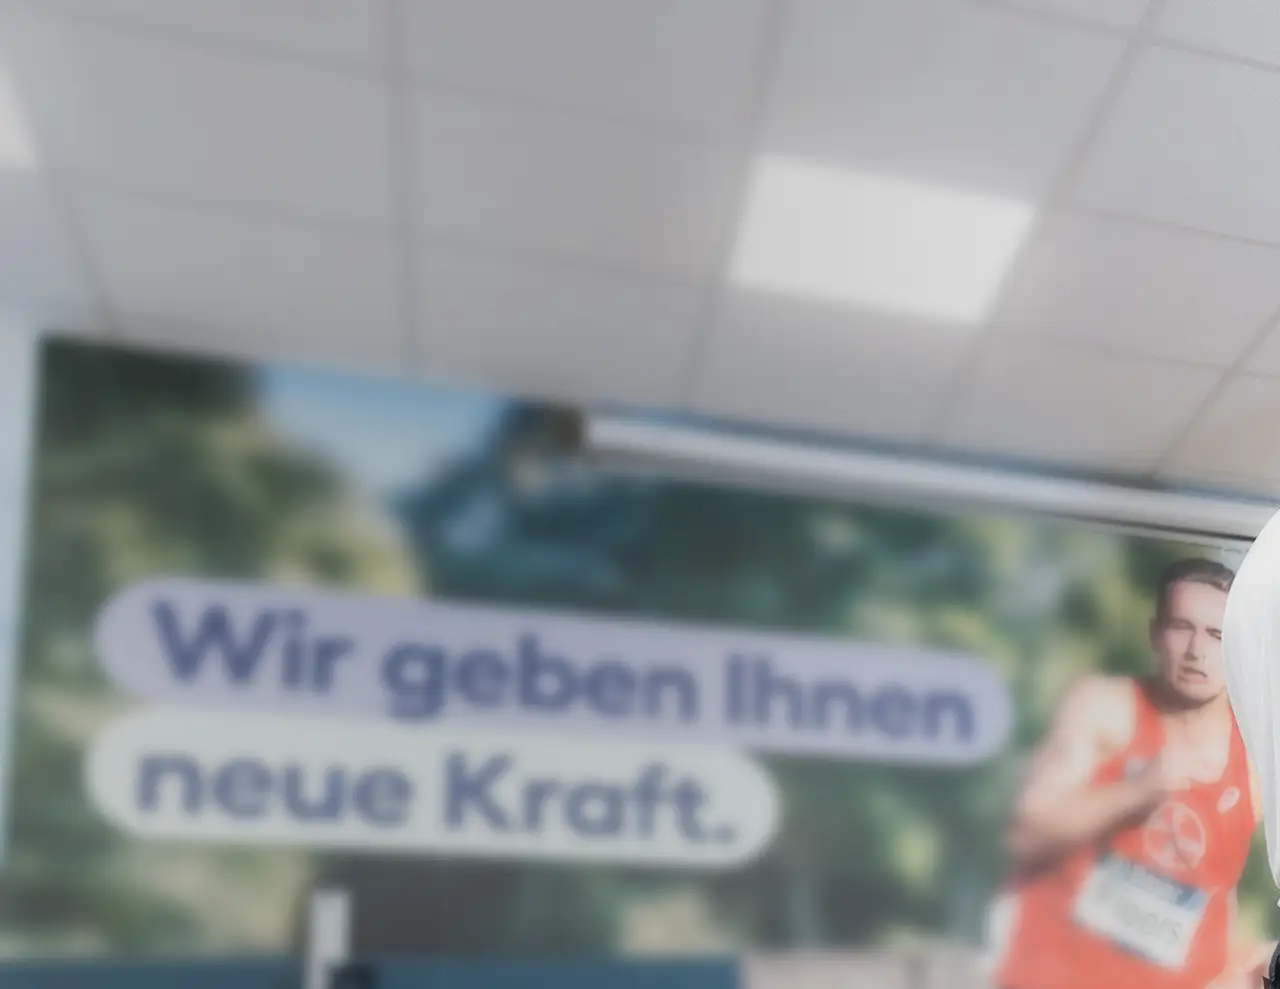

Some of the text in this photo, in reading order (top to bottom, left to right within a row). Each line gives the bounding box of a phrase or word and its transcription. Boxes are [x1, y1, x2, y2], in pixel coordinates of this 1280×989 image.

[149, 600, 978, 743] Wir geben Ihnen
[138, 750, 737, 844] neue Kraft.
